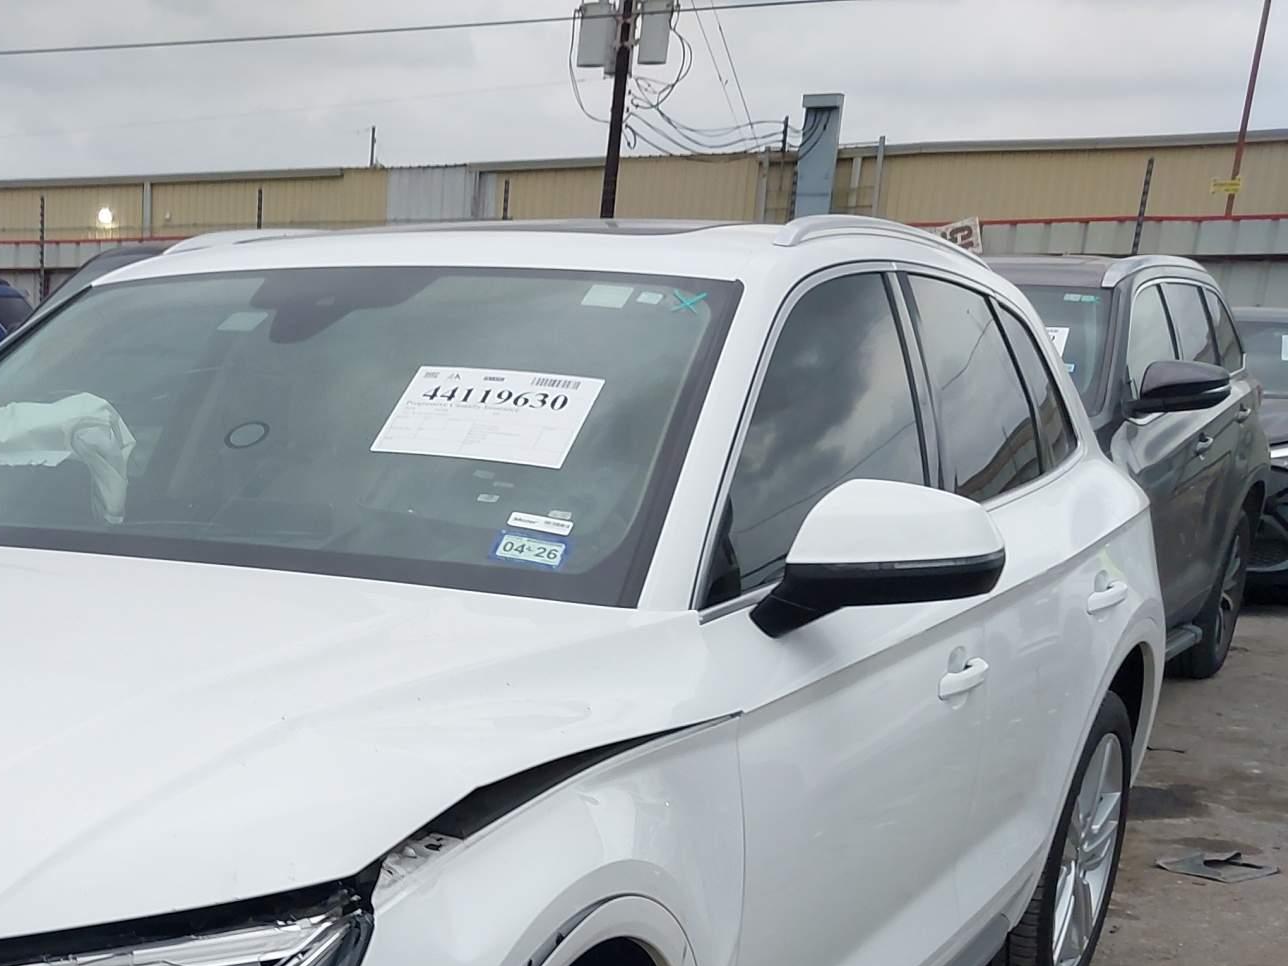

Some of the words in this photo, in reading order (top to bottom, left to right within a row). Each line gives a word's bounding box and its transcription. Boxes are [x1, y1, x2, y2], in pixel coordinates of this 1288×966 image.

[422, 385, 569, 412] 44119630
[502, 541, 527, 555] 04
[534, 546, 560, 561] 26
